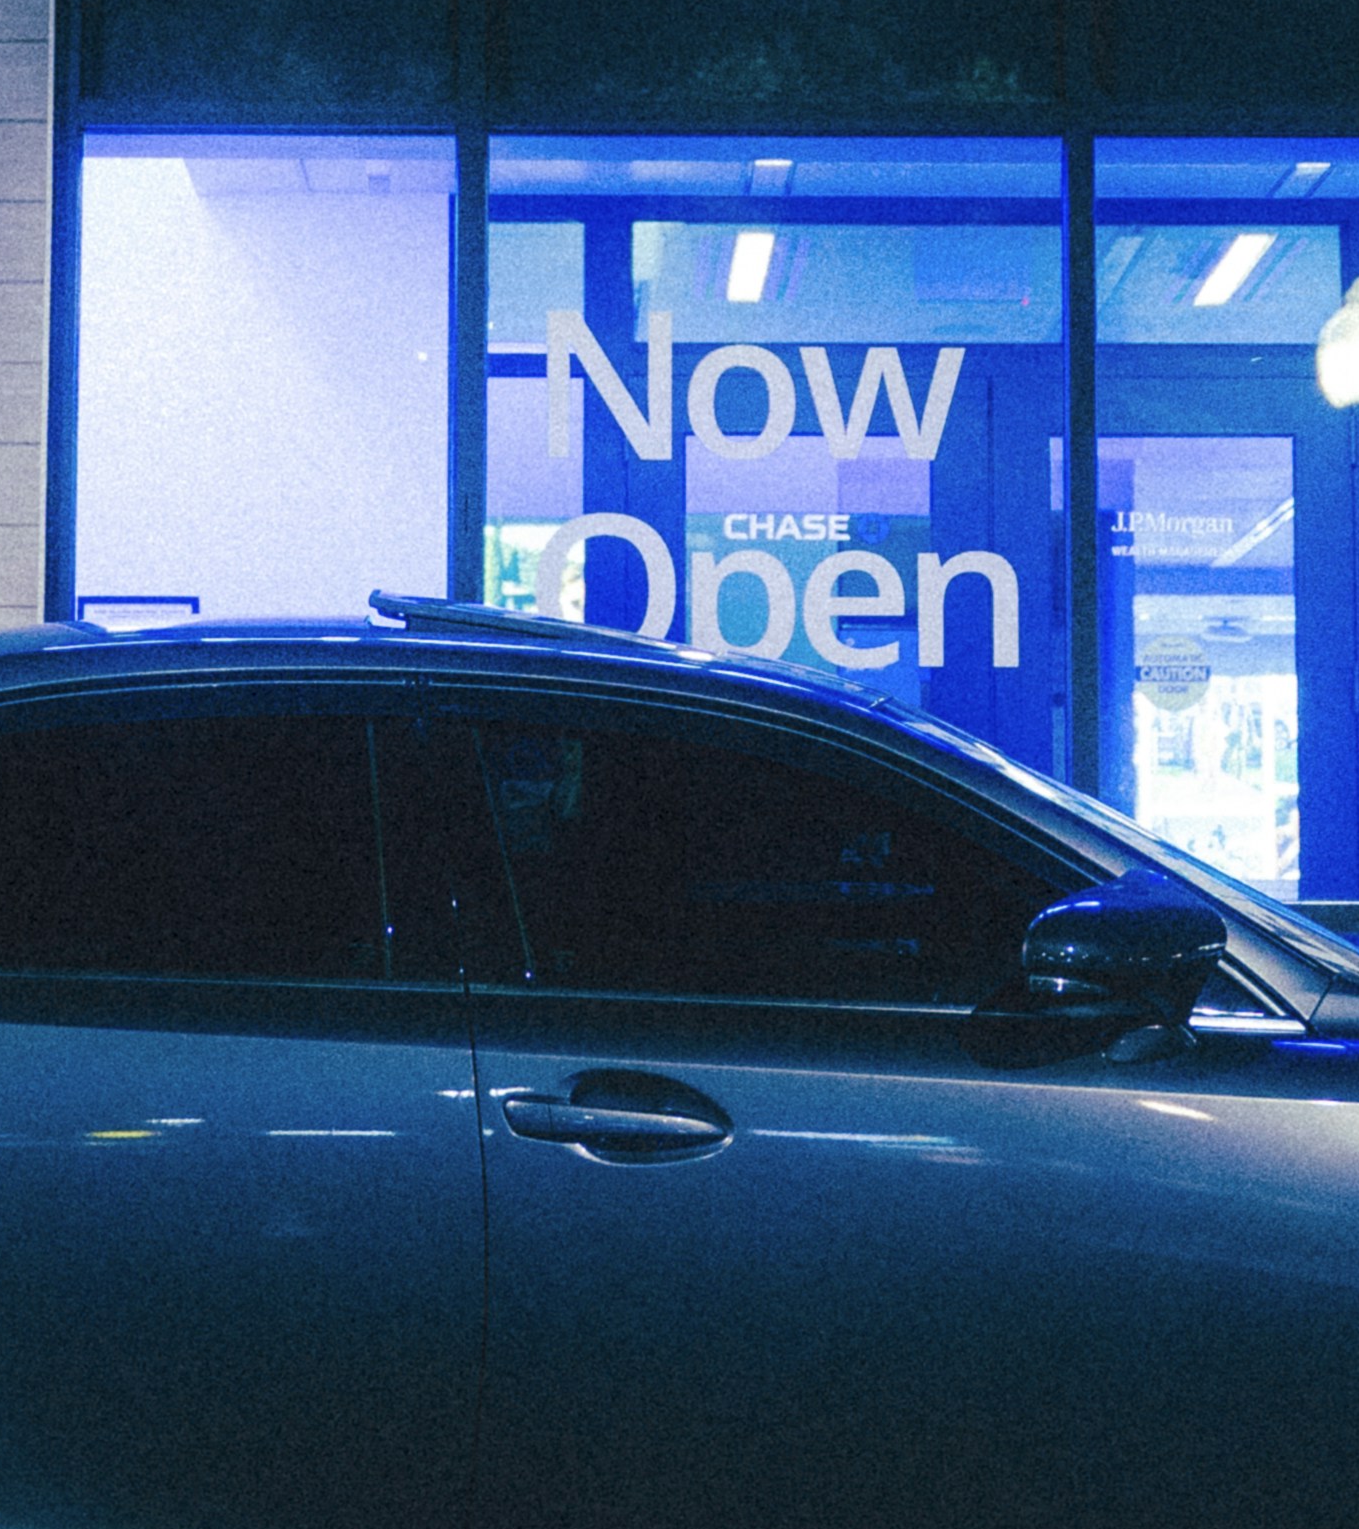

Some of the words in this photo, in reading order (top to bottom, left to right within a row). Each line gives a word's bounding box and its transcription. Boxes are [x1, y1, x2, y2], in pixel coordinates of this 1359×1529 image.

[545, 309, 967, 463] Now
[723, 512, 851, 541] CHASE
[535, 511, 1020, 670] Open
[1139, 665, 1207, 682] CAUTION
